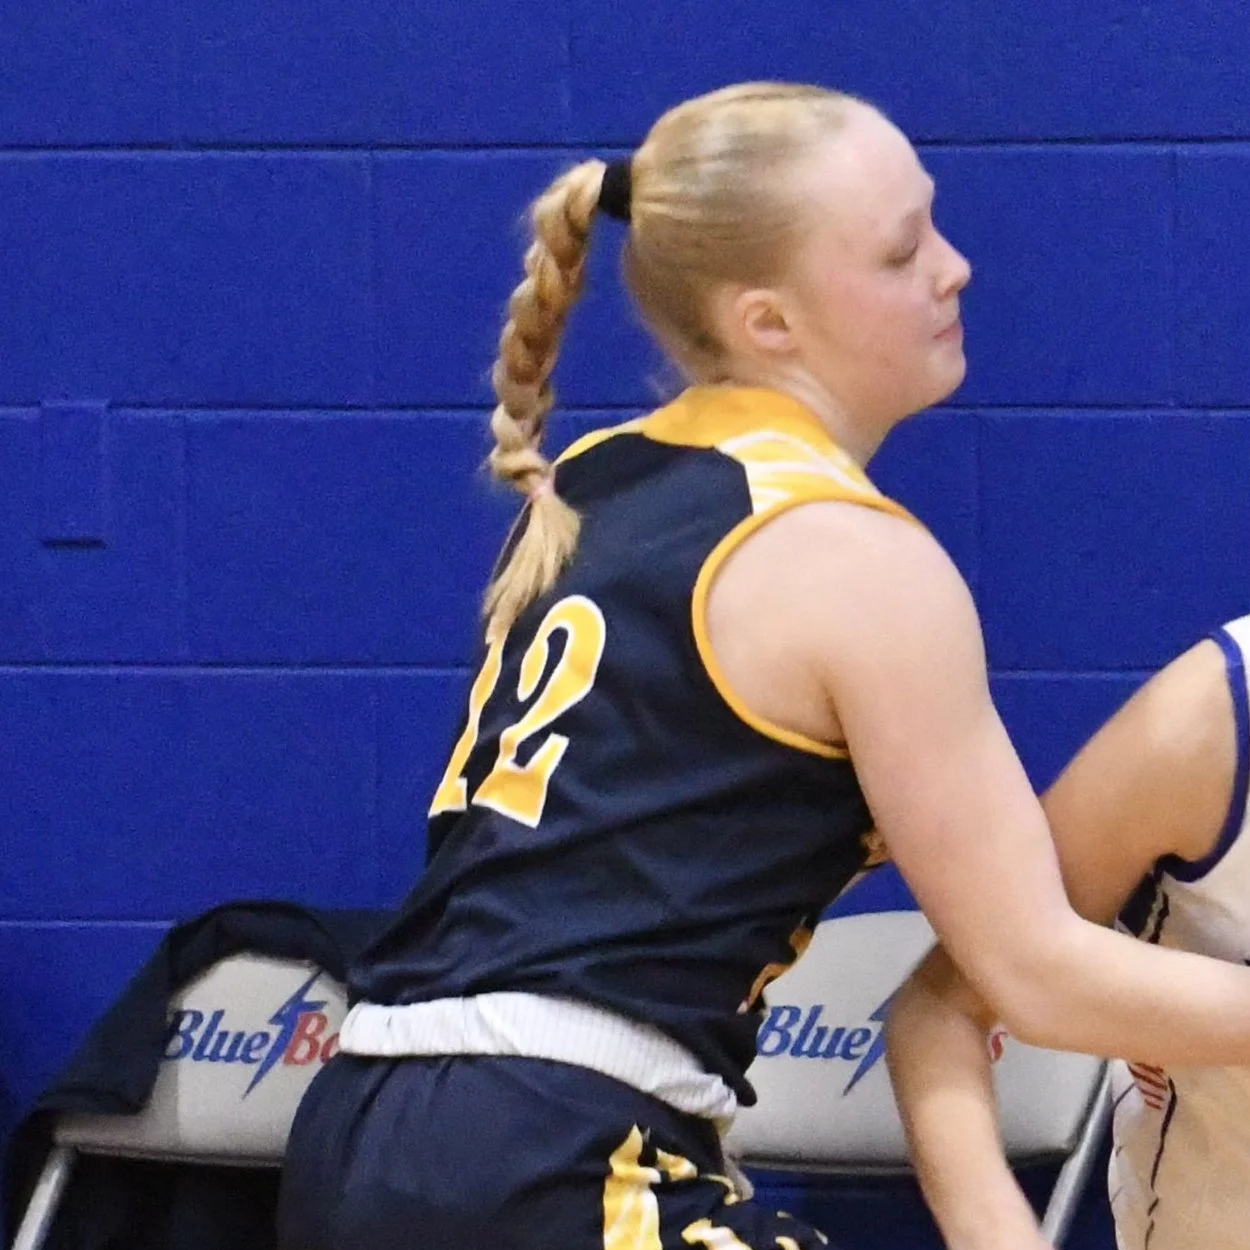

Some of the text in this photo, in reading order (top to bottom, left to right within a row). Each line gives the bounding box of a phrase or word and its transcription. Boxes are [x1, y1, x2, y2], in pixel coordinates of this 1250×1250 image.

[428, 595, 606, 828] 12
[164, 1009, 270, 1064] Blue
[757, 1004, 873, 1061] Blue
